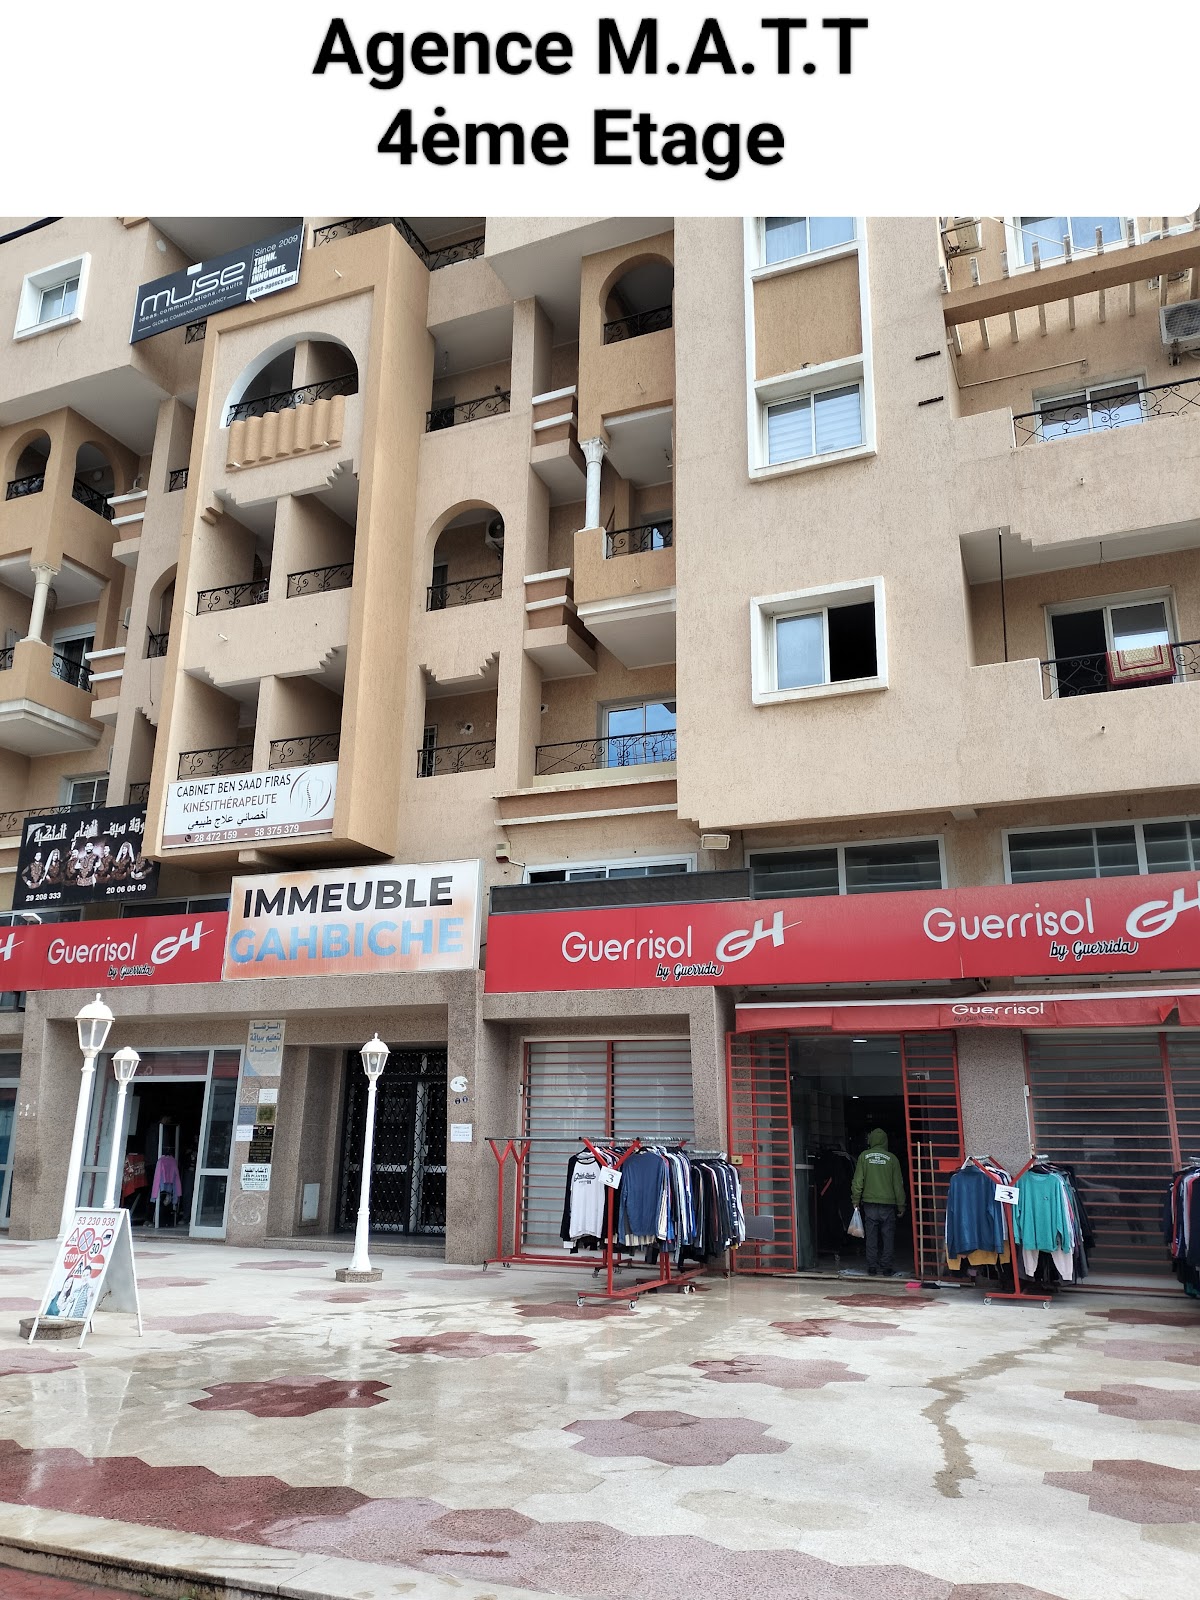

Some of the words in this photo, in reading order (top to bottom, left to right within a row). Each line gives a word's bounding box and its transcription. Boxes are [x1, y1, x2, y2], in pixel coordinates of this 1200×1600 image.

[254, 244, 277, 257] Since
[278, 234, 299, 248] 2009
[253, 250, 278, 267] THINK.
[250, 263, 287, 284] INNOVATE.
[251, 262, 268, 276] ACT.
[139, 261, 246, 317] muse
[151, 317, 169, 328] GLOBAL
[169, 304, 207, 321] COMMUNICATION
[207, 296, 227, 307] AGENCY
[176, 783, 216, 798] CABINET
[217, 779, 236, 794] BEN
[238, 776, 262, 792] SAAD
[264, 773, 292, 788] FIRAS
[182, 793, 278, 814] KINÉSITHÉRAPEUTE
[102, 821, 127, 838] سيف
[187, 815, 212, 831] طبيعي
[213, 814, 234, 829] علاج
[194, 833, 205, 843] 28
[205, 832, 221, 842] 472
[222, 830, 238, 840] 159
[254, 828, 265, 837] 58
[266, 826, 283, 836] 375
[283, 823, 300, 834] 379
[25, 894, 35, 902] 29
[35, 893, 48, 901] 208
[48, 892, 62, 900] 333
[106, 886, 116, 895] 20
[127, 885, 137, 893] 06
[137, 883, 147, 892] 09
[243, 876, 453, 919] IMMEUBLE
[922, 897, 1095, 943] Guerrisol
[48, 933, 138, 965] Guerrisol
[229, 917, 465, 964] GAHBICHE
[561, 925, 692, 963] Guerrisol
[1049, 940, 1068, 962] by
[1072, 936, 1139, 962] Guerrida
[106, 964, 118, 981] by
[120, 962, 156, 981] Guerrida
[656, 963, 671, 981] by
[673, 961, 725, 981] Guerrida
[951, 1002, 1044, 1015] Guerrisol
[605, 1173, 615, 1184] 3
[999, 1190, 1014, 1200] 3
[77, 1216, 87, 1226] 53
[87, 1216, 101, 1226] 230
[101, 1217, 116, 1227] 938
[64, 1253, 78, 1263] STOP
[90, 1243, 100, 1255] 30
